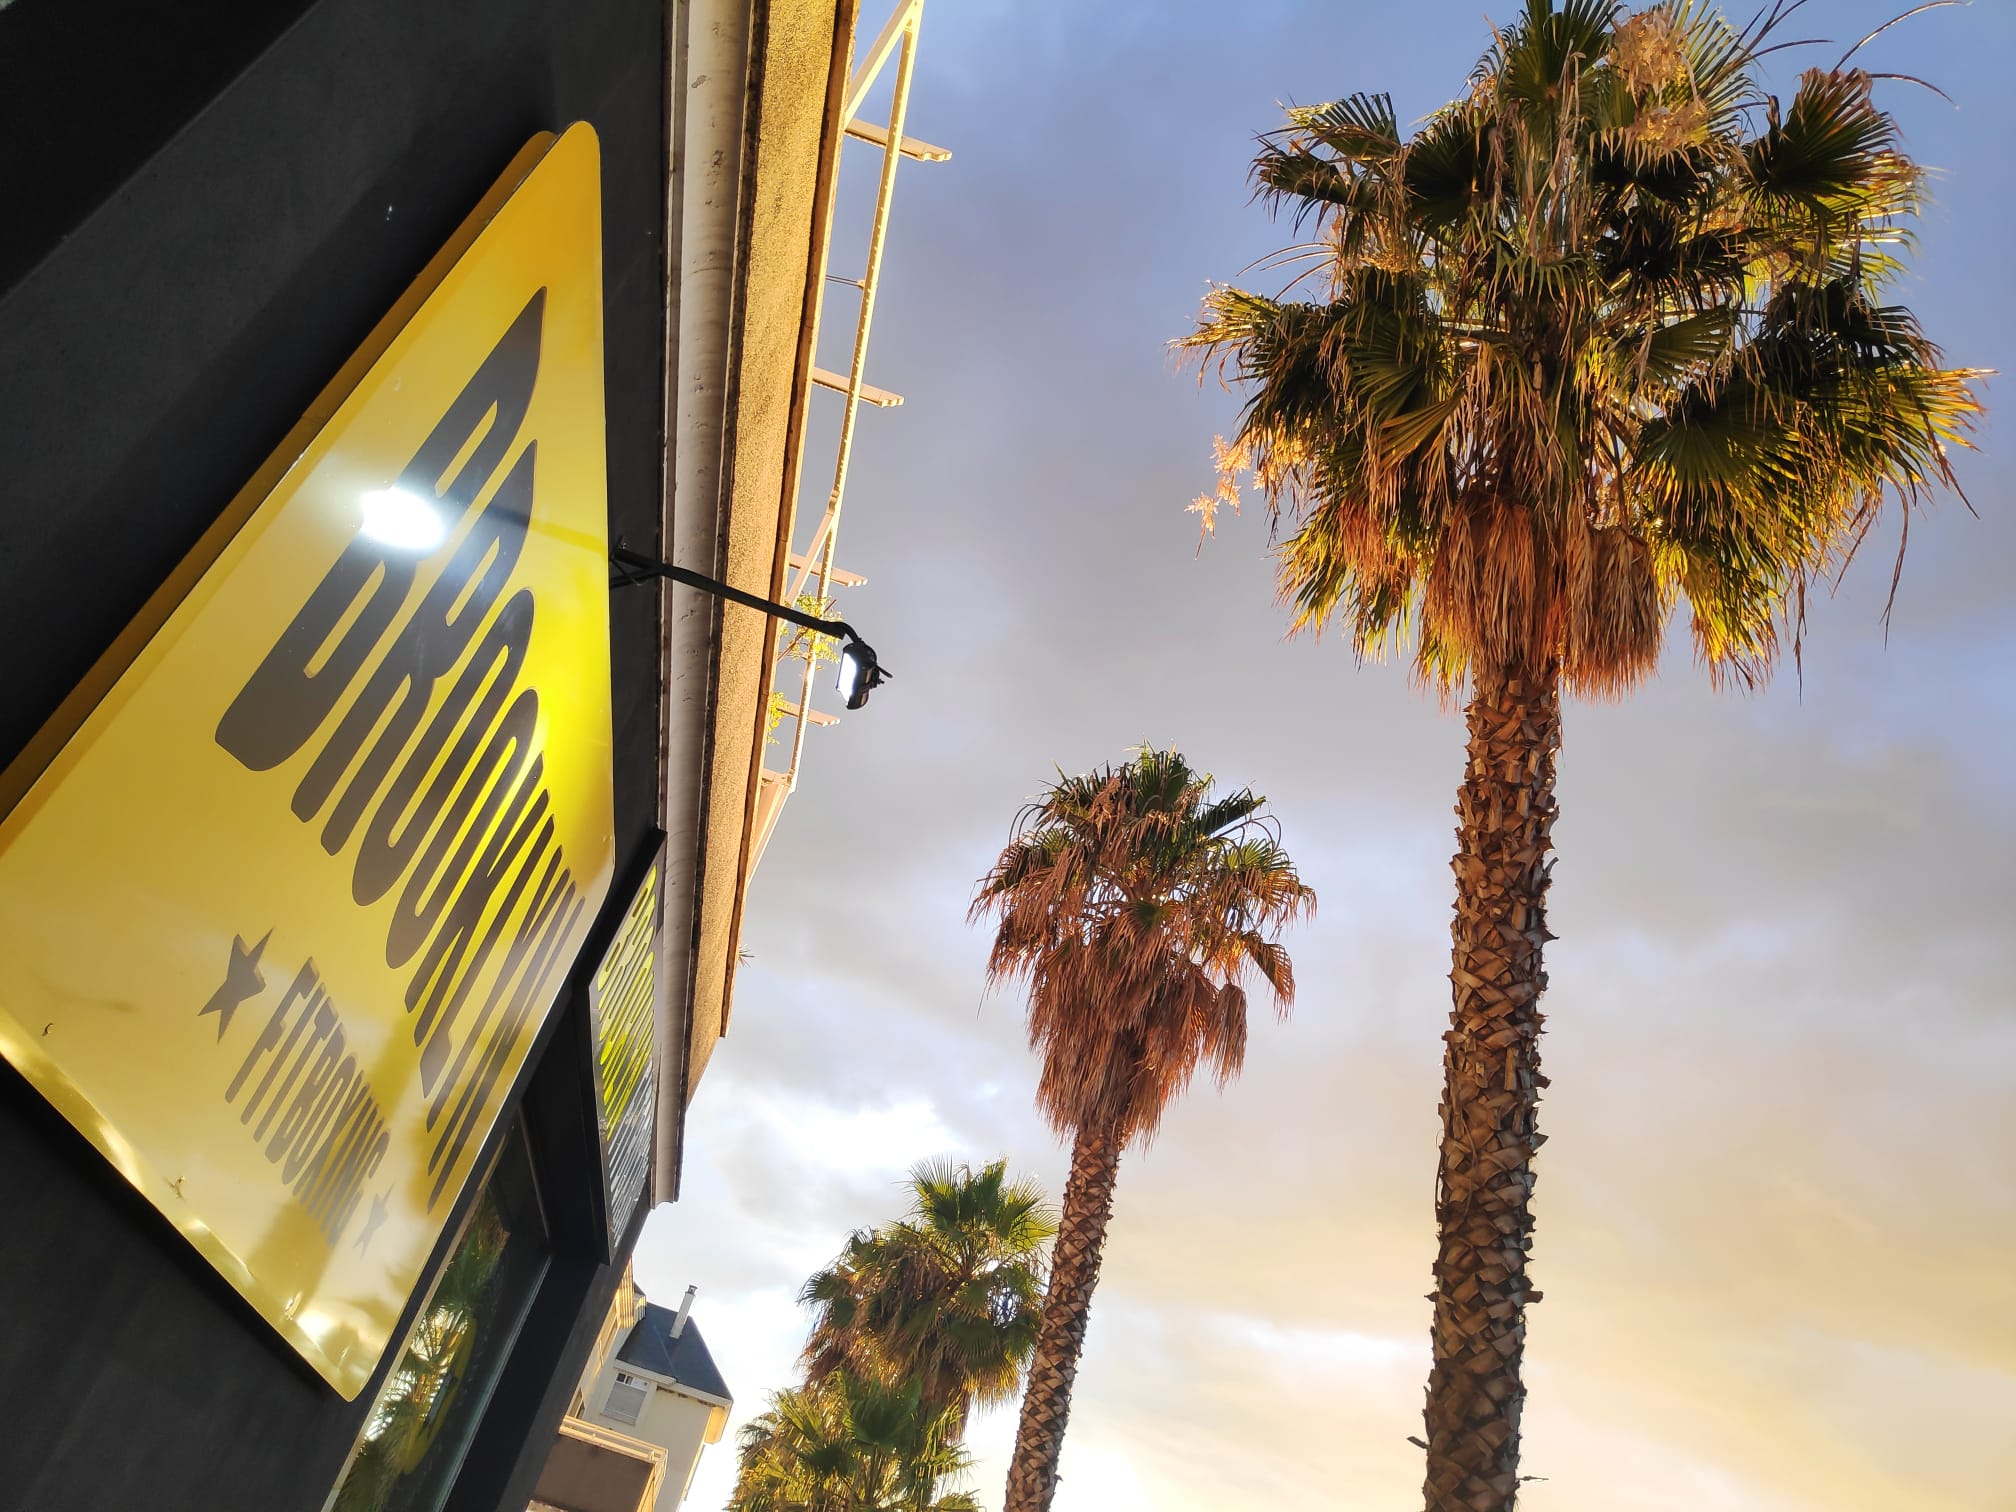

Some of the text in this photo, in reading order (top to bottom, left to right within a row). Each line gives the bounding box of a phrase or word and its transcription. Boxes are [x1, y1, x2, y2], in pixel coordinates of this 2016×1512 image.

[214, 285, 586, 1215] BROOKLYN
[224, 956, 392, 1248] FITBOXING
[597, 863, 658, 1142] BROOKLYN
